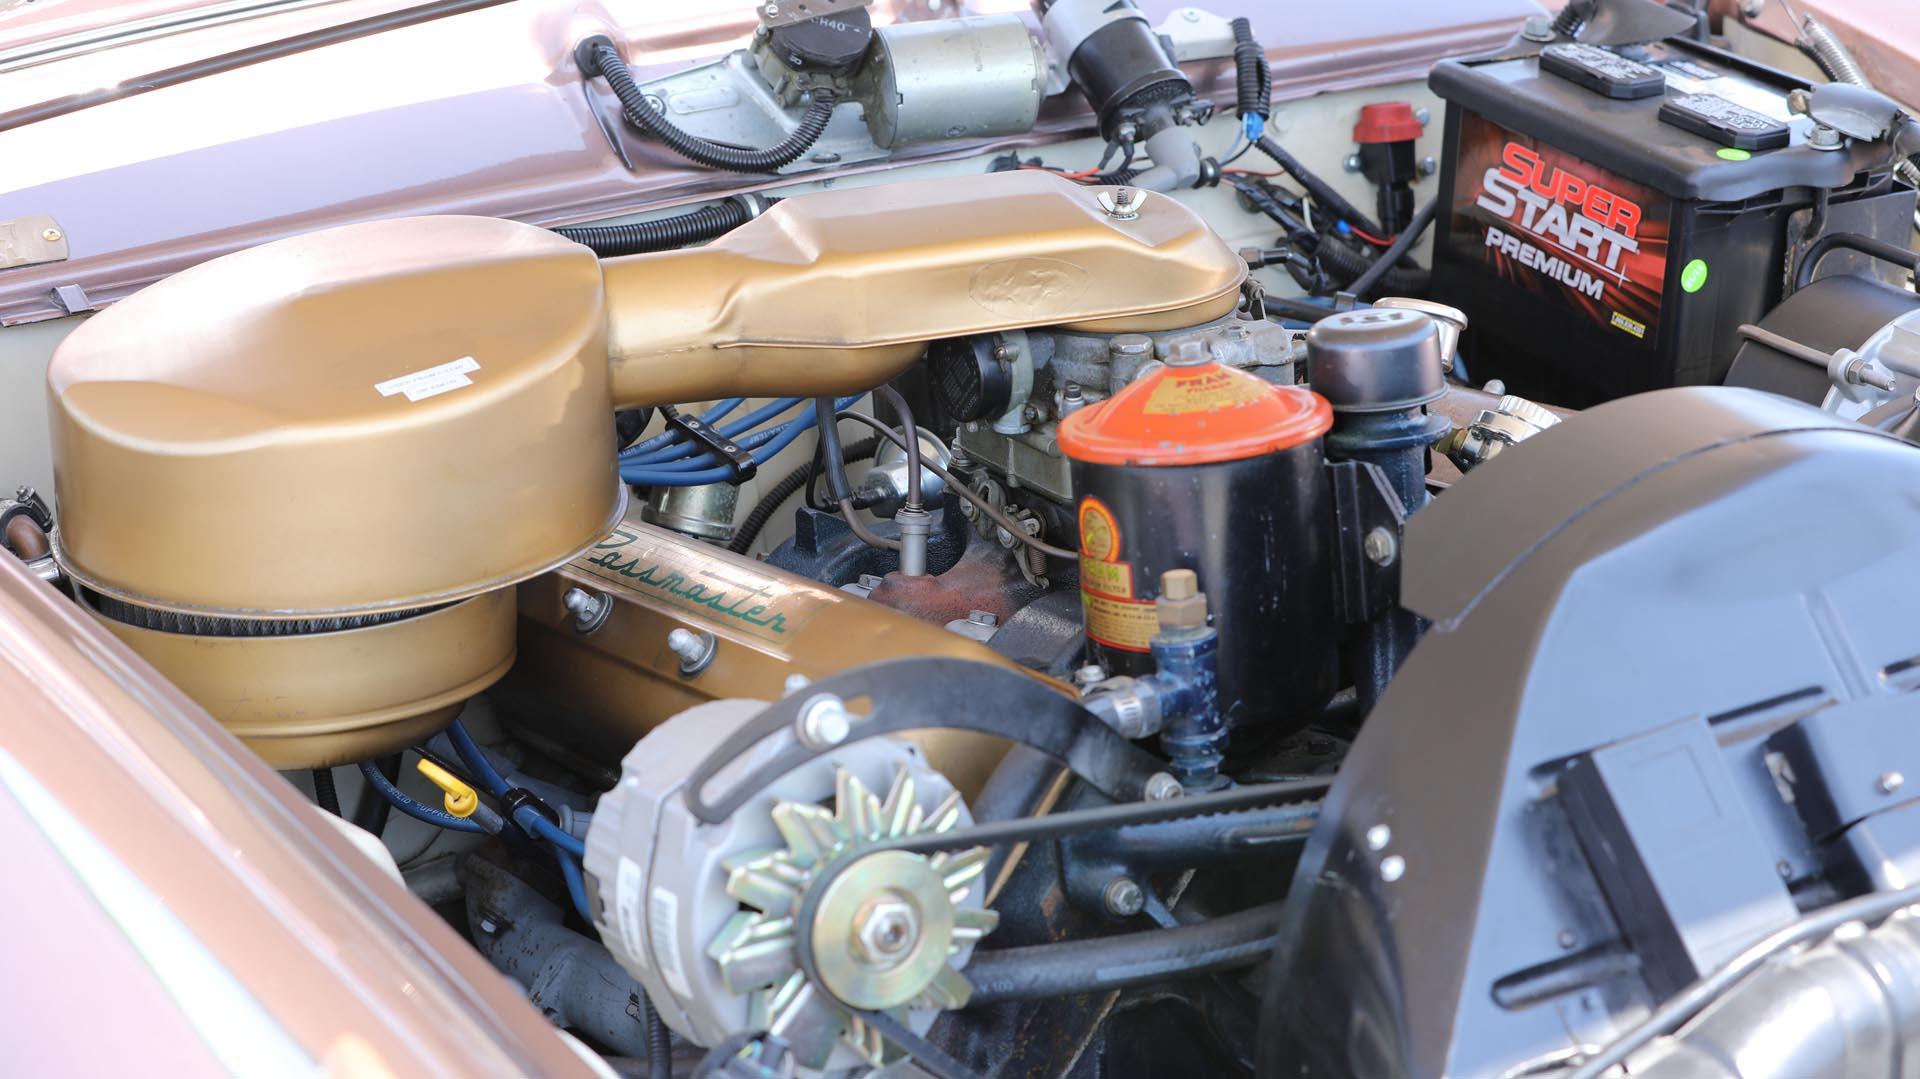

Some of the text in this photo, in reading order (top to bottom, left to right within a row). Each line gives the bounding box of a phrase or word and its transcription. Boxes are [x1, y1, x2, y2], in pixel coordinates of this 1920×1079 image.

[1476, 167, 1640, 271] START
[1499, 141, 1642, 239] SUPER
[1485, 226, 1605, 301] PREMIUM
